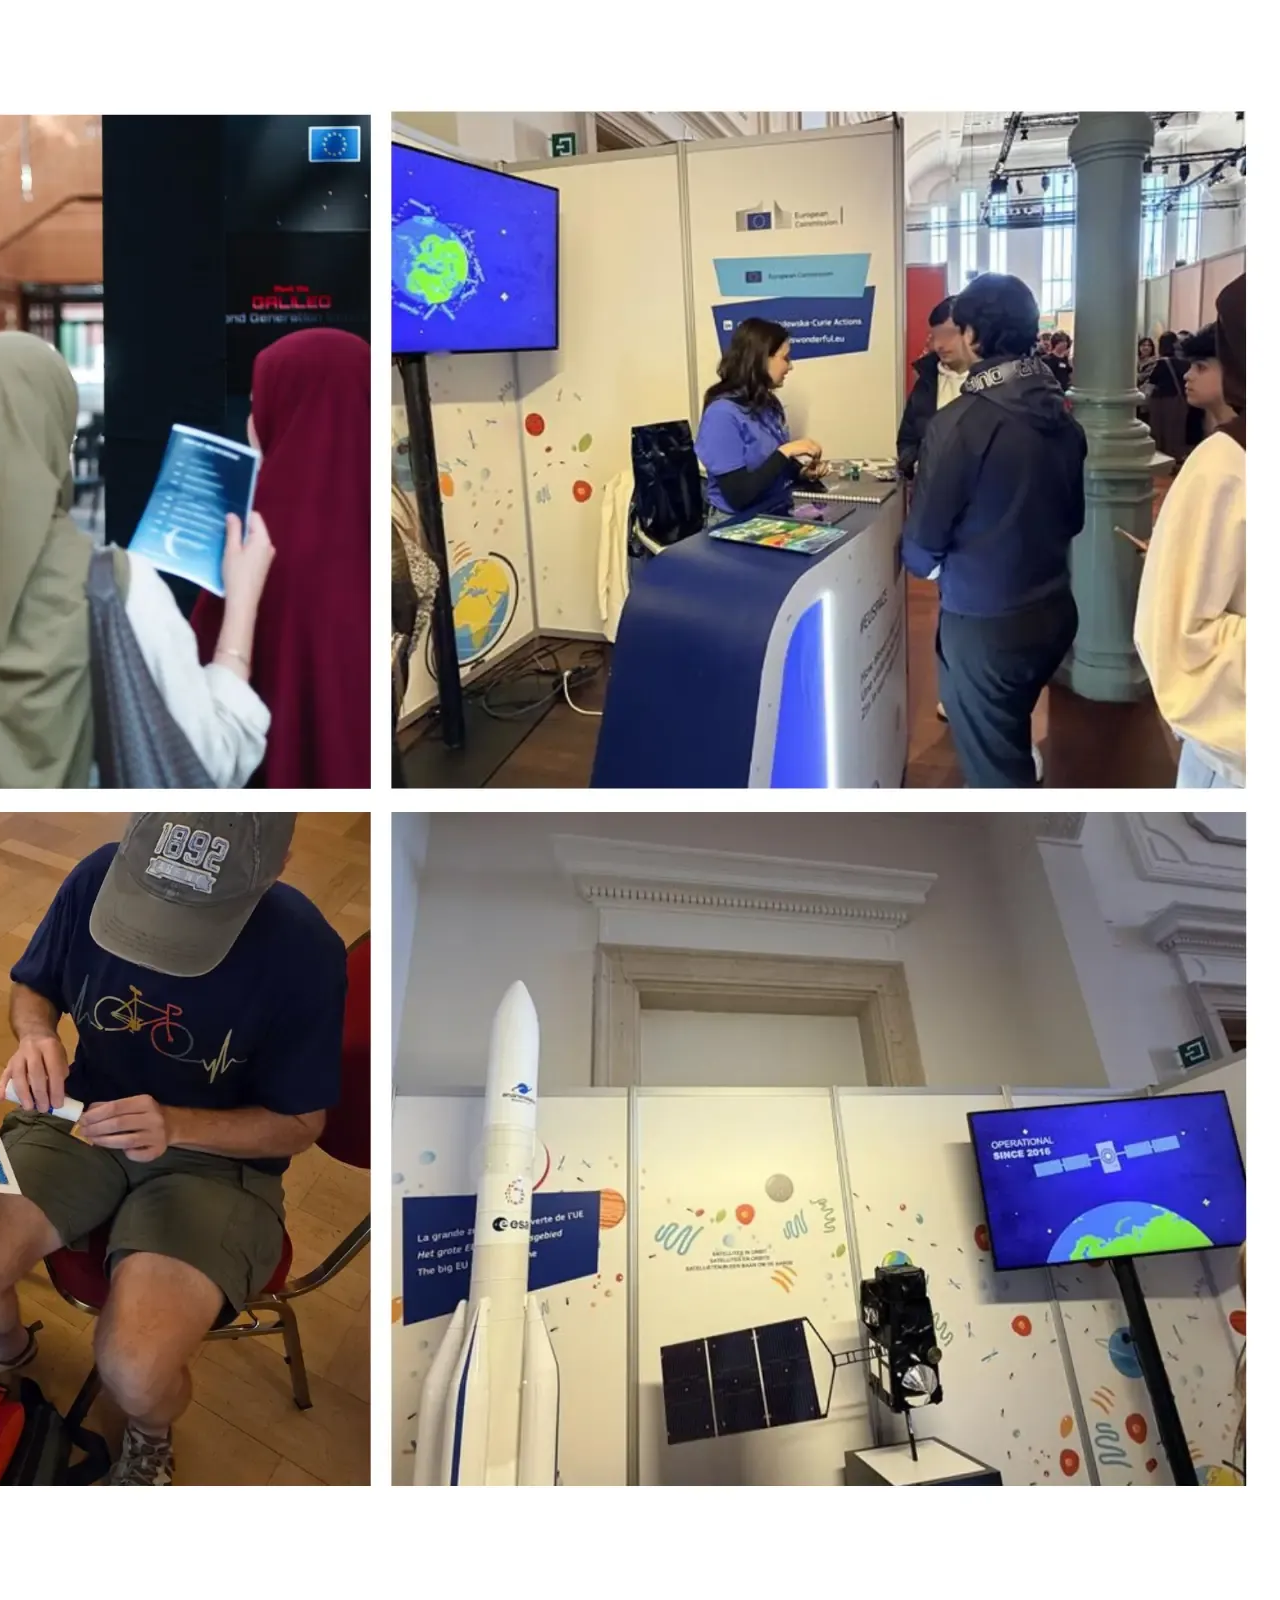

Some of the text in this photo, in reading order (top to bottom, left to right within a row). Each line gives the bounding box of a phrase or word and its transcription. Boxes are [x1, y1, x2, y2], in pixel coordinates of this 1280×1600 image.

[252, 295, 332, 310] GALILEO
[834, 318, 862, 327] Actions
[154, 822, 230, 874] 1892
[991, 1136, 1055, 1150] OPERATIONAL
[993, 1149, 1025, 1161] SINCE
[417, 1234, 429, 1243] La
[432, 1228, 465, 1242] grande
[530, 1215, 553, 1226] verte
[555, 1213, 566, 1223] de
[417, 1249, 434, 1260] Het
[436, 1246, 462, 1259] grote
[417, 1267, 436, 1277] The
[437, 1264, 453, 1275] big
[455, 1260, 469, 1270] EU
